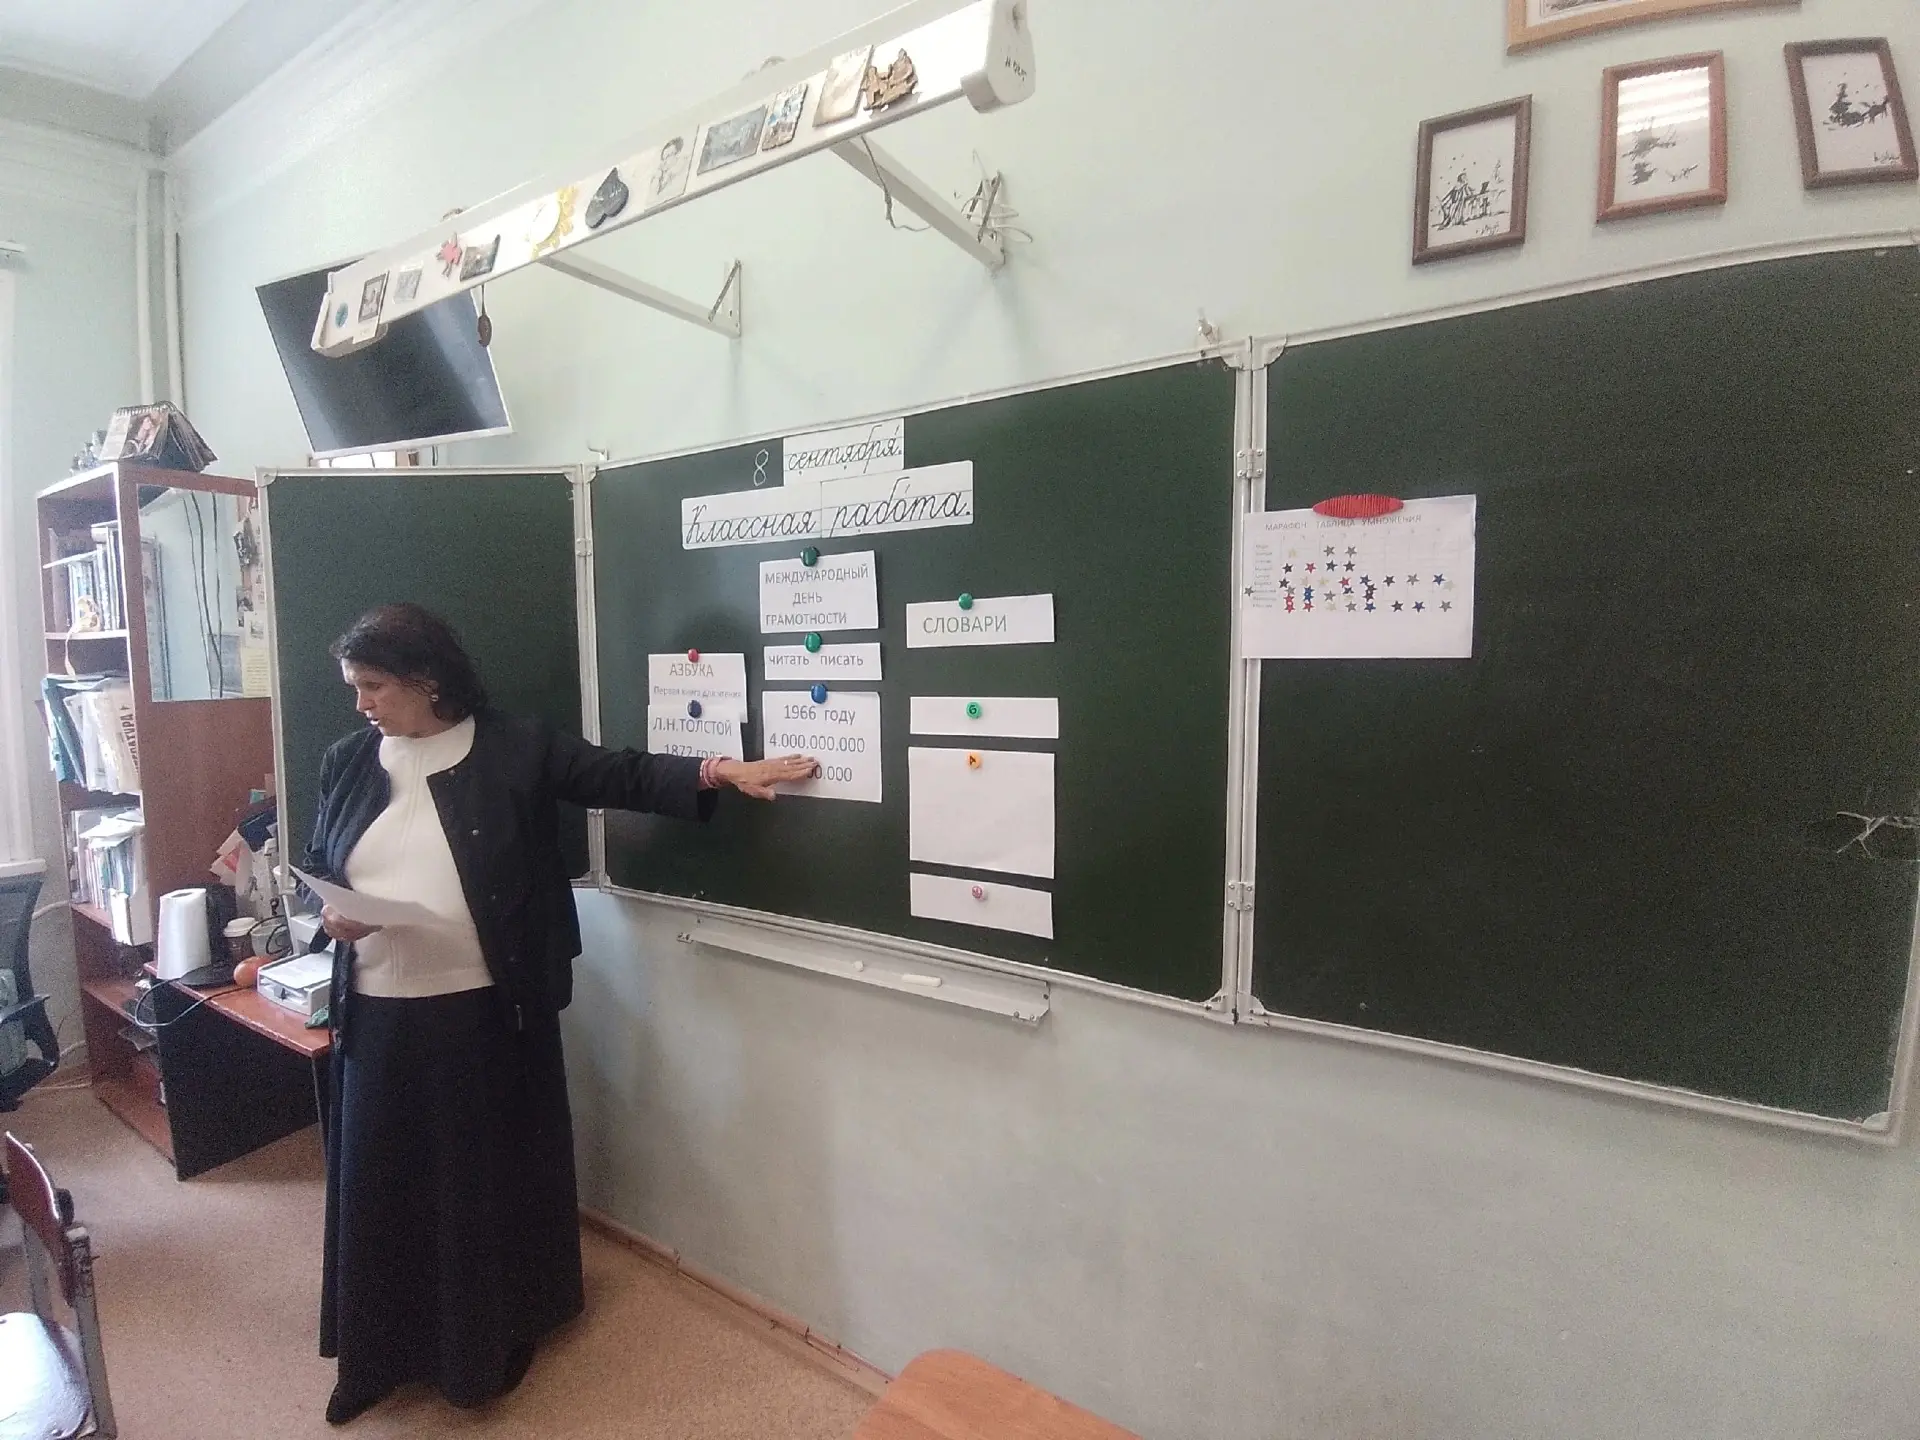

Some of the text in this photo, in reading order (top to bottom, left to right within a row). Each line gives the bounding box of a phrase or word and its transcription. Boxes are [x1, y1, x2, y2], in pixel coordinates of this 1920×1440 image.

[753, 448, 770, 487] 8
[686, 504, 817, 545] Классная
[1265, 514, 1422, 531] МАРАФОН ТАБЛИЦА УМНОЖЕНИЯ
[765, 563, 869, 584] МЕЖДУНАРОДНЫЙ
[792, 592, 823, 606] ДЕНЬ
[765, 612, 847, 626] ГРАМОТНОСТИ
[923, 614, 1007, 634] СЛОВАРИ
[768, 654, 864, 667] читать писать
[669, 663, 715, 678] АЗБУКА
[653, 686, 680, 697] Первая
[783, 704, 856, 726] 1966 году
[652, 717, 733, 737] Л.Н.ТОЛСТОЙ
[664, 743, 693, 758] 1872
[769, 733, 865, 753] 4.000.000.000
